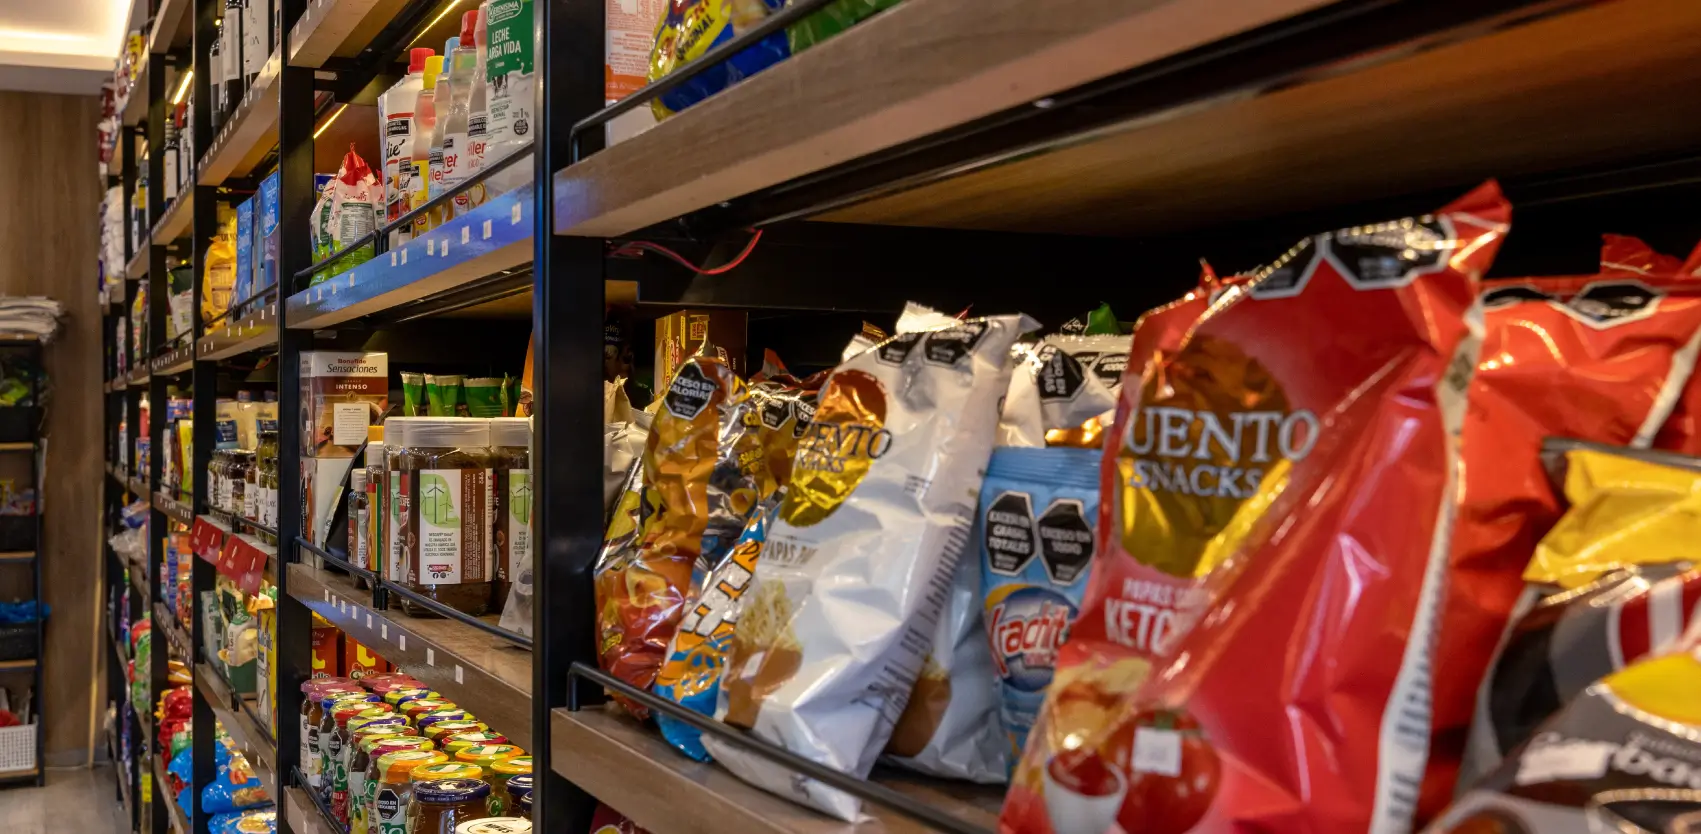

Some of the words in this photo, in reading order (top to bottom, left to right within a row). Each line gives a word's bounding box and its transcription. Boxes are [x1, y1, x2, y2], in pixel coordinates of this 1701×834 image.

[492, 27, 510, 44] LECHE
[487, 44, 503, 61] ARGA
[503, 41, 521, 55] VIDA
[327, 364, 378, 374] Sensaciones
[678, 377, 700, 387] CESO
[671, 386, 709, 400] ALORIA
[1125, 406, 1320, 462] UENTO
[1131, 460, 1264, 499] SNACKS
